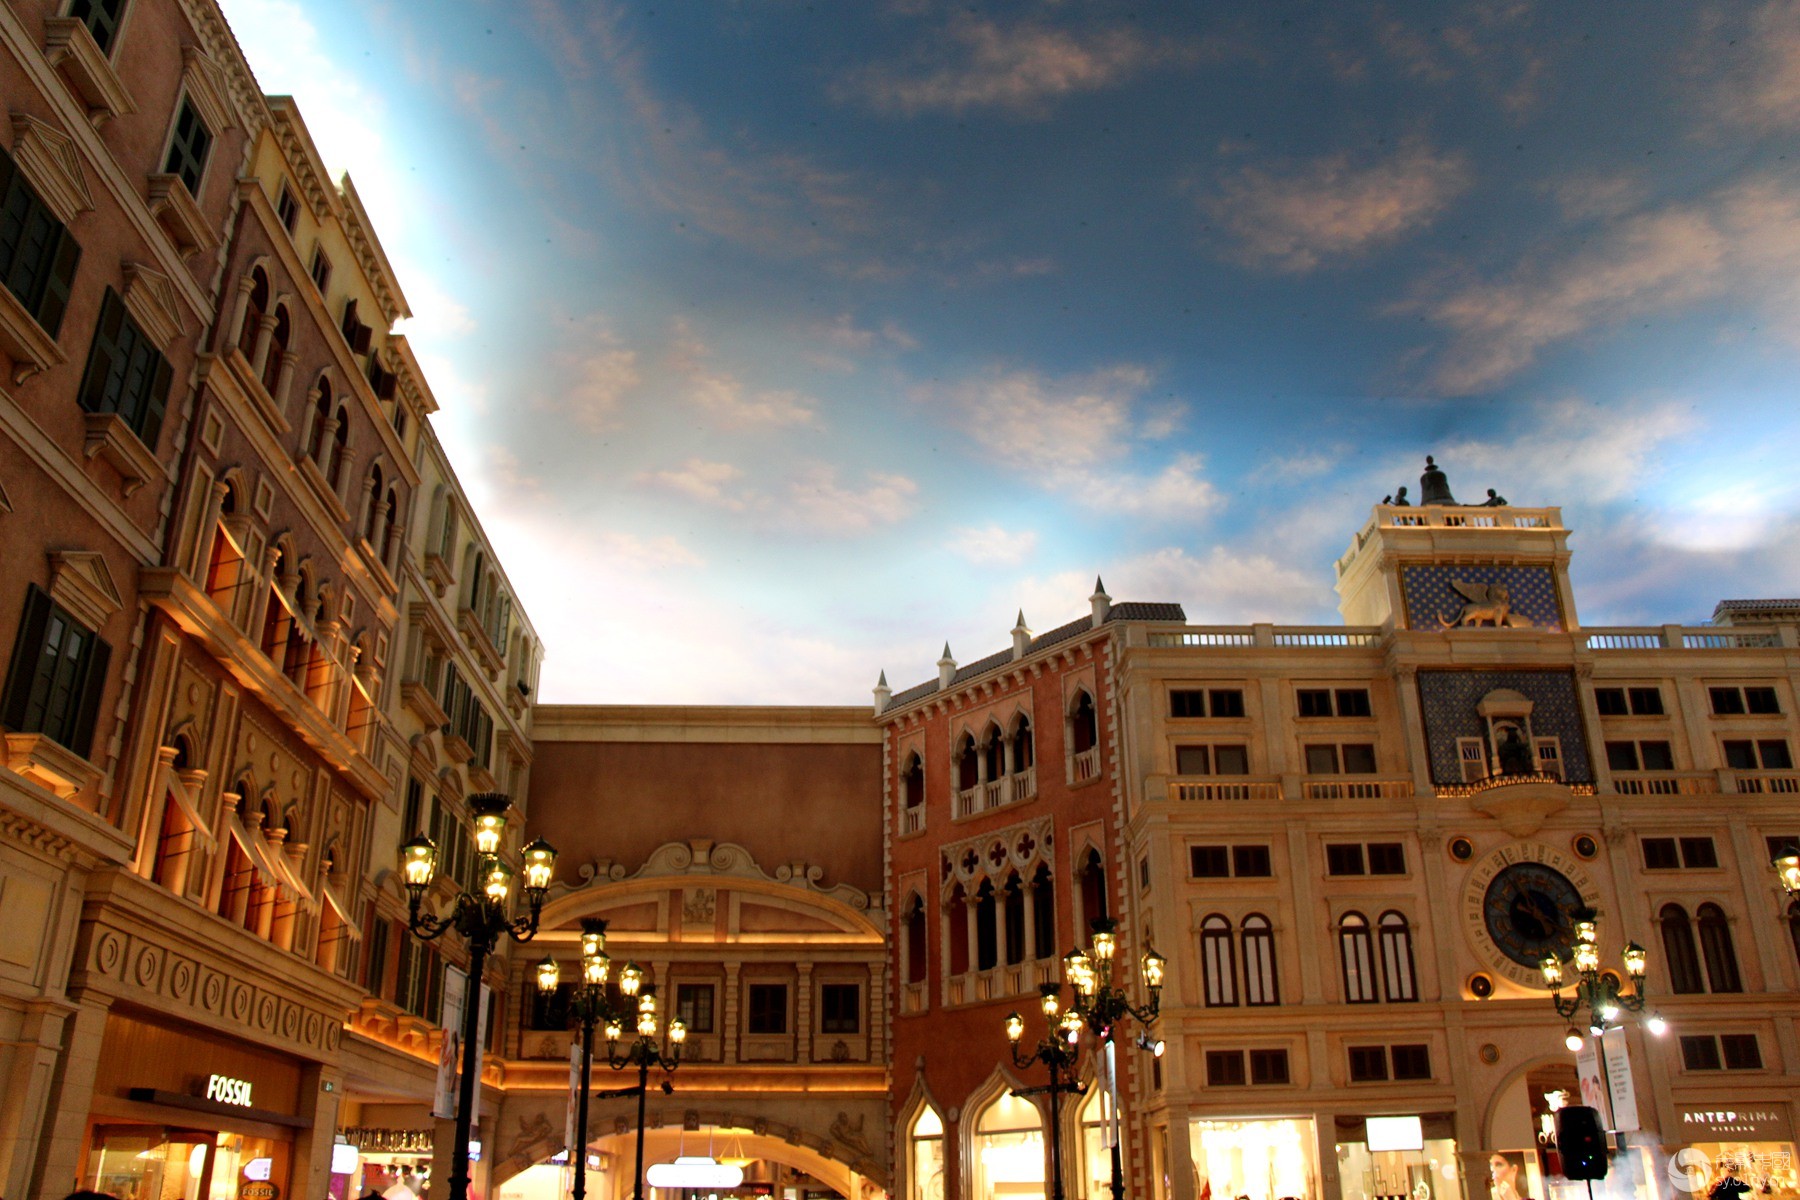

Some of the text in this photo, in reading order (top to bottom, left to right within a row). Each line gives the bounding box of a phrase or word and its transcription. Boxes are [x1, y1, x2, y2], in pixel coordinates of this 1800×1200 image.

[206, 1074, 252, 1107] FOSSIL
[1683, 1111, 1779, 1123] ANTEPRIMA
[242, 1188, 274, 1196] FOSSIL
